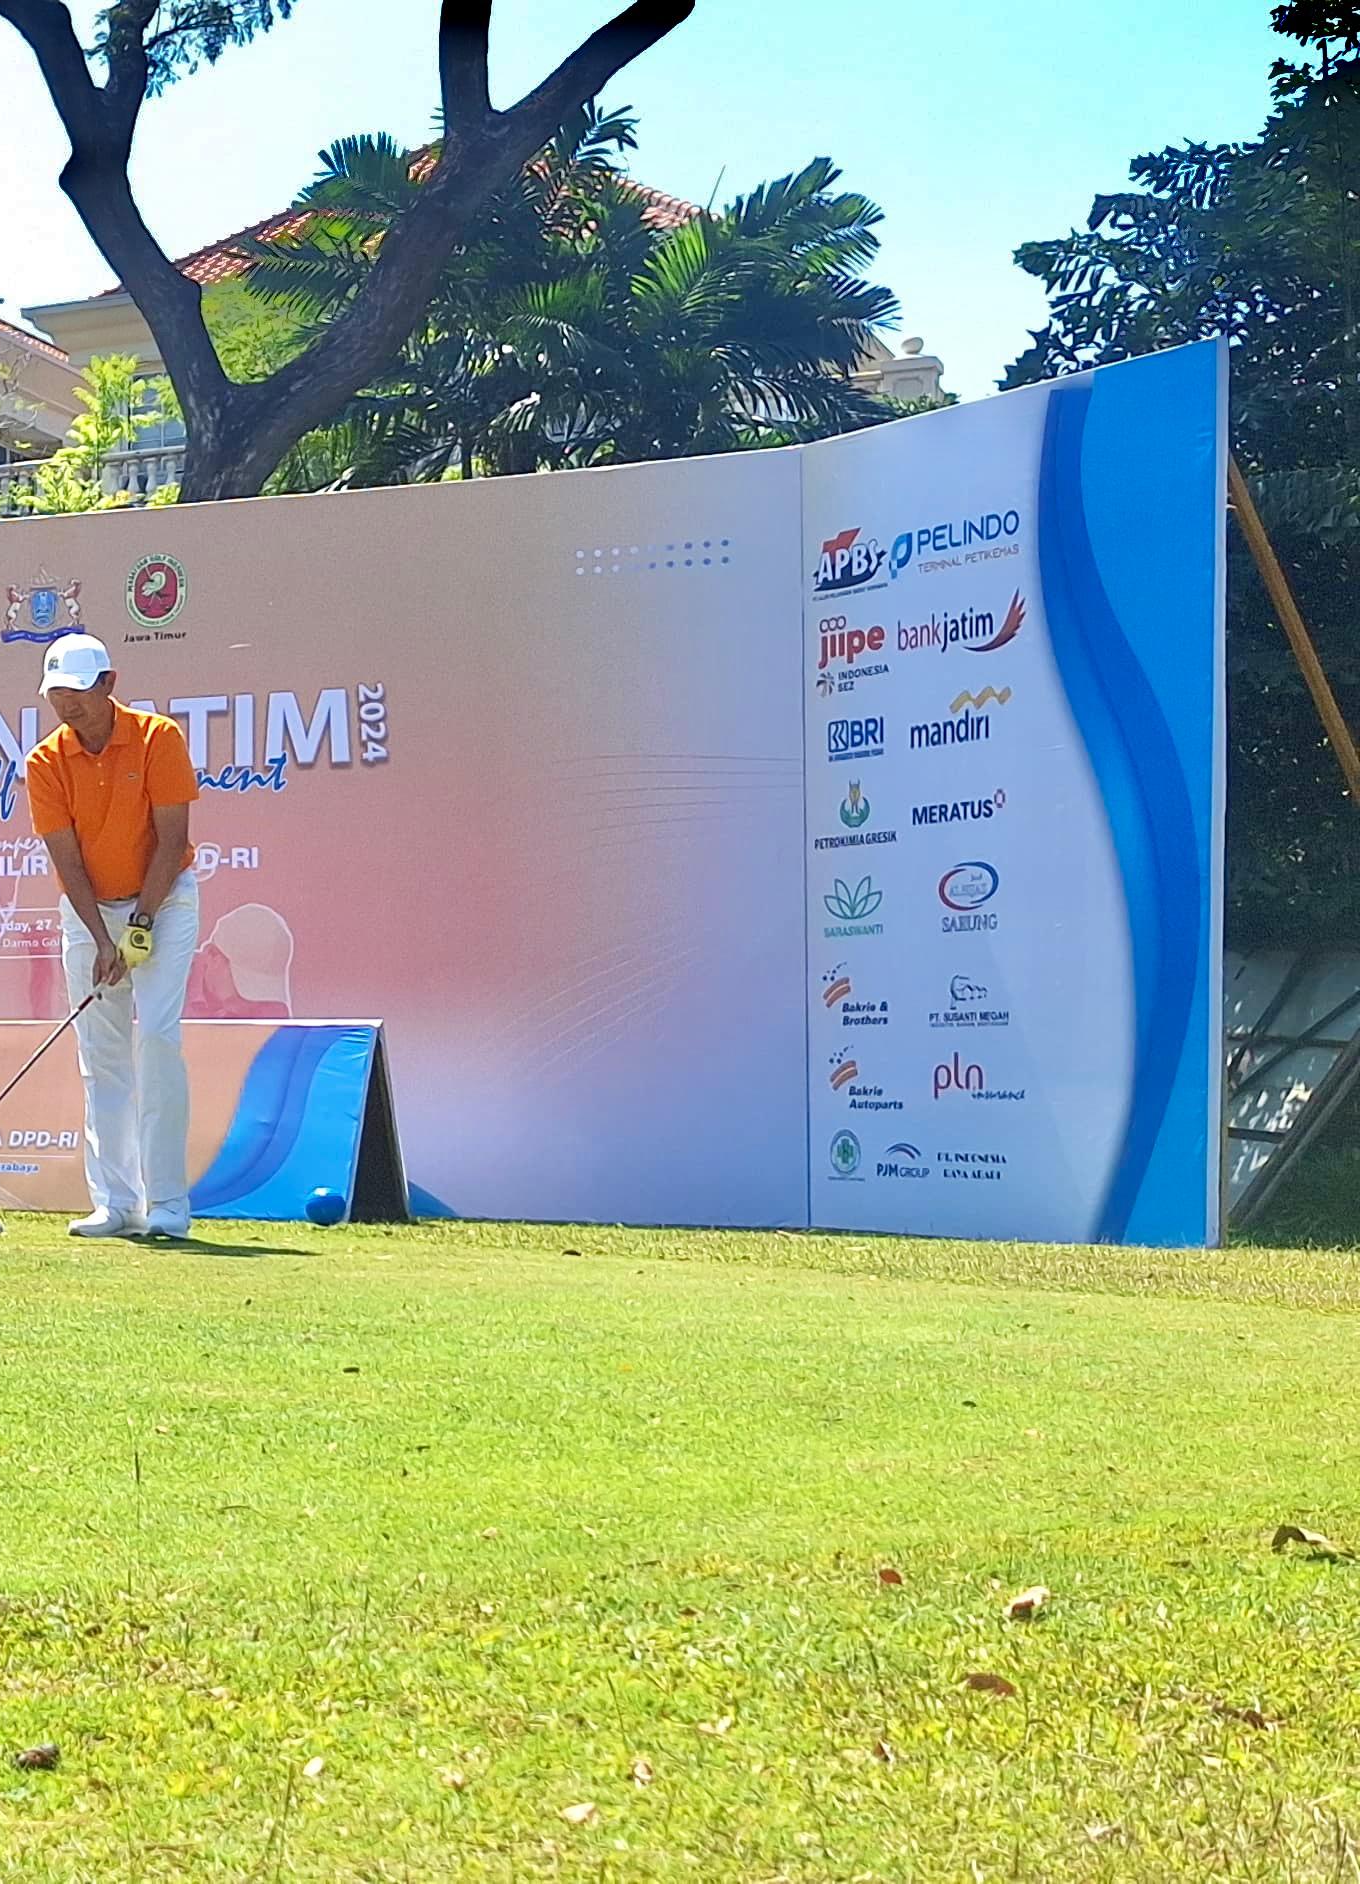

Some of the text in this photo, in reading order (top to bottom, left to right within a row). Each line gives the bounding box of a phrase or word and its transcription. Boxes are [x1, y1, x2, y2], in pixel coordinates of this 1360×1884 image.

[918, 511, 1020, 554] PELINDO
[818, 537, 880, 584] APBS
[124, 632, 187, 643] Jawa Timur
[897, 607, 995, 653] bankjatim
[818, 624, 885, 669] jiipe
[838, 664, 890, 681] INDONESIA
[838, 681, 855, 692] SEZ
[358, 682, 388, 763] 2024
[850, 716, 884, 748] BRI
[912, 798, 994, 826] MERATUS
[198, 847, 259, 869] D-RI
[36, 919, 52, 931] 27
[41, 936, 60, 948] Gol
[842, 1001, 888, 1013] Bakrie &
[842, 1015, 888, 1027] Brothers
[934, 1051, 984, 1100] pln
[848, 1086, 883, 1096] Bakrie
[849, 1099, 904, 1111] Autoparts
[8, 1131, 79, 1149] DPD-RI
